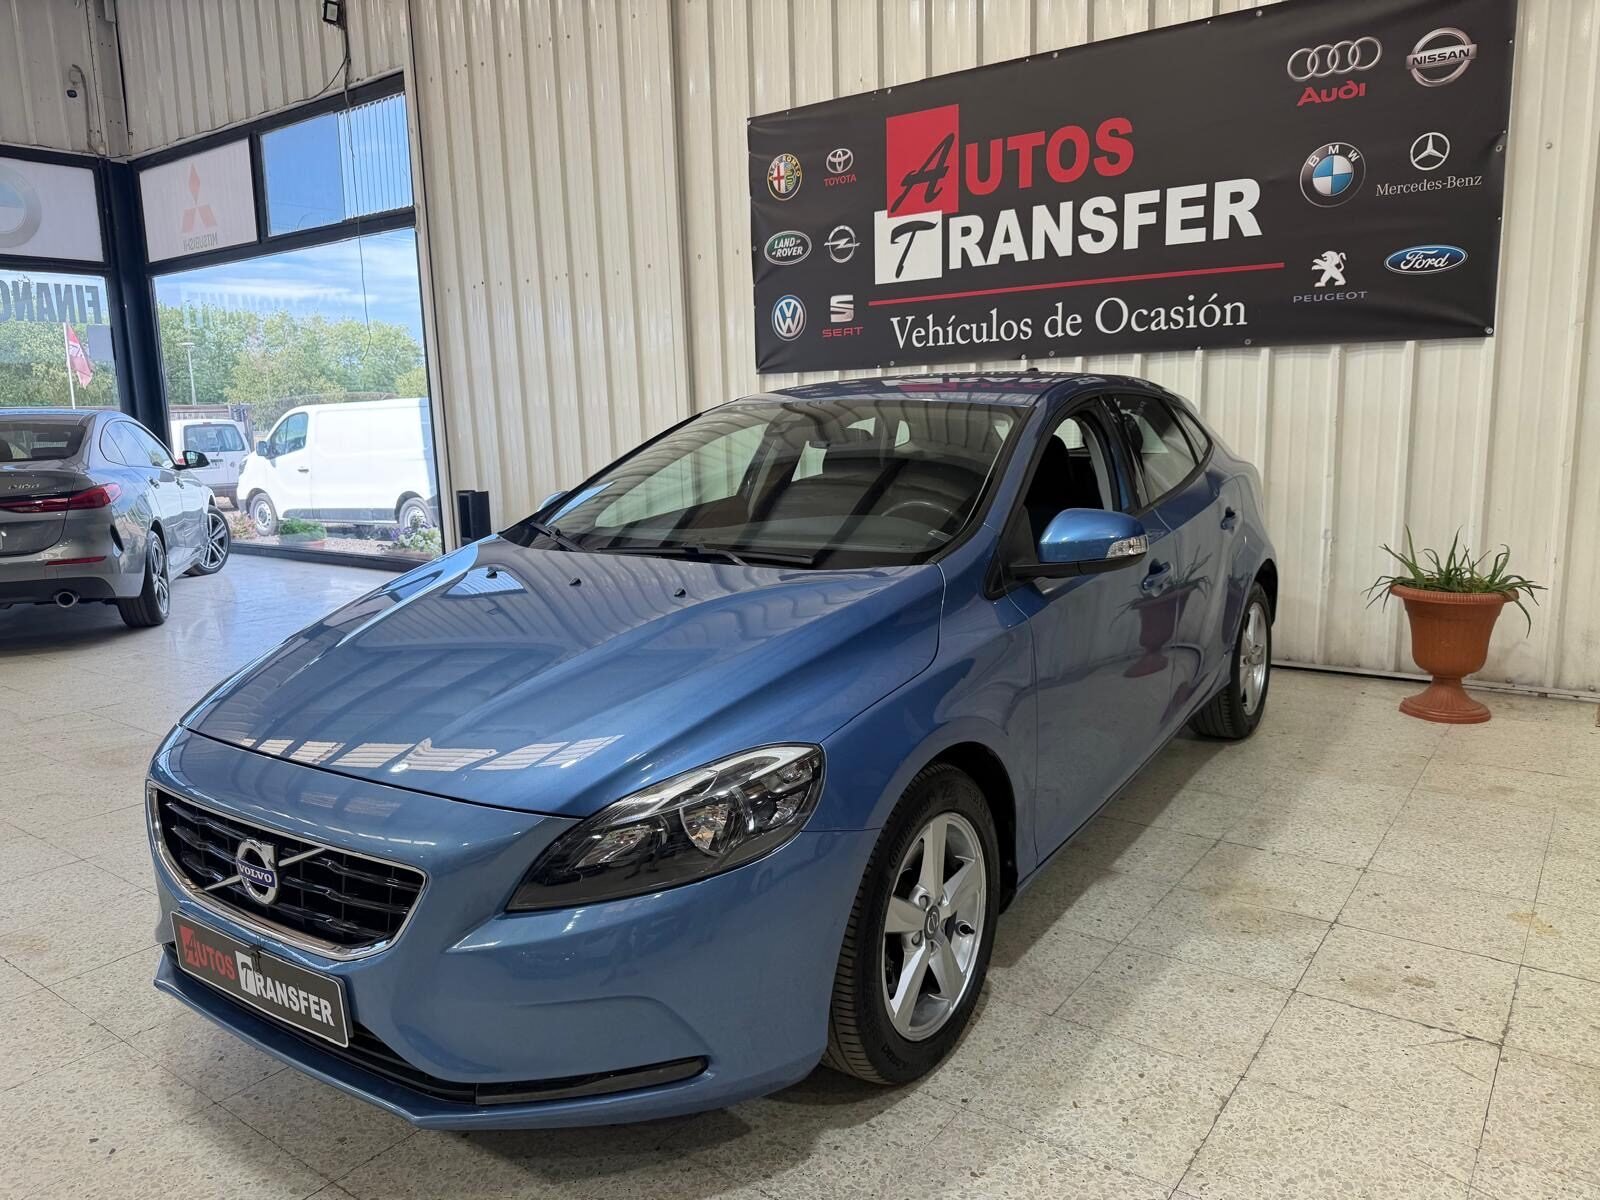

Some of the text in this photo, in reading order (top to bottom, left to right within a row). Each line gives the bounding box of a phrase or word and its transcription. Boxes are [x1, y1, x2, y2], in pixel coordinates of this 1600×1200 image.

[1411, 48, 1471, 66] NISSAN
[1296, 80, 1367, 106] Audi
[889, 117, 1136, 214] AUTOS
[1308, 144, 1360, 168] BMW
[823, 174, 857, 187] TOYOTA
[1375, 174, 1483, 197] Mercedes-Benz
[889, 178, 1264, 280] TRANSFER
[774, 237, 796, 249] LAND
[776, 246, 803, 258] ROVER
[1400, 249, 1449, 270] Ford
[1293, 291, 1368, 303] PEUGEOT
[890, 293, 1248, 349] Vehículos de Ocasión
[821, 326, 864, 338] SEAT
[238, 864, 272, 884] VOLVO
[182, 929, 335, 1027] AUTOS TRANSFER
